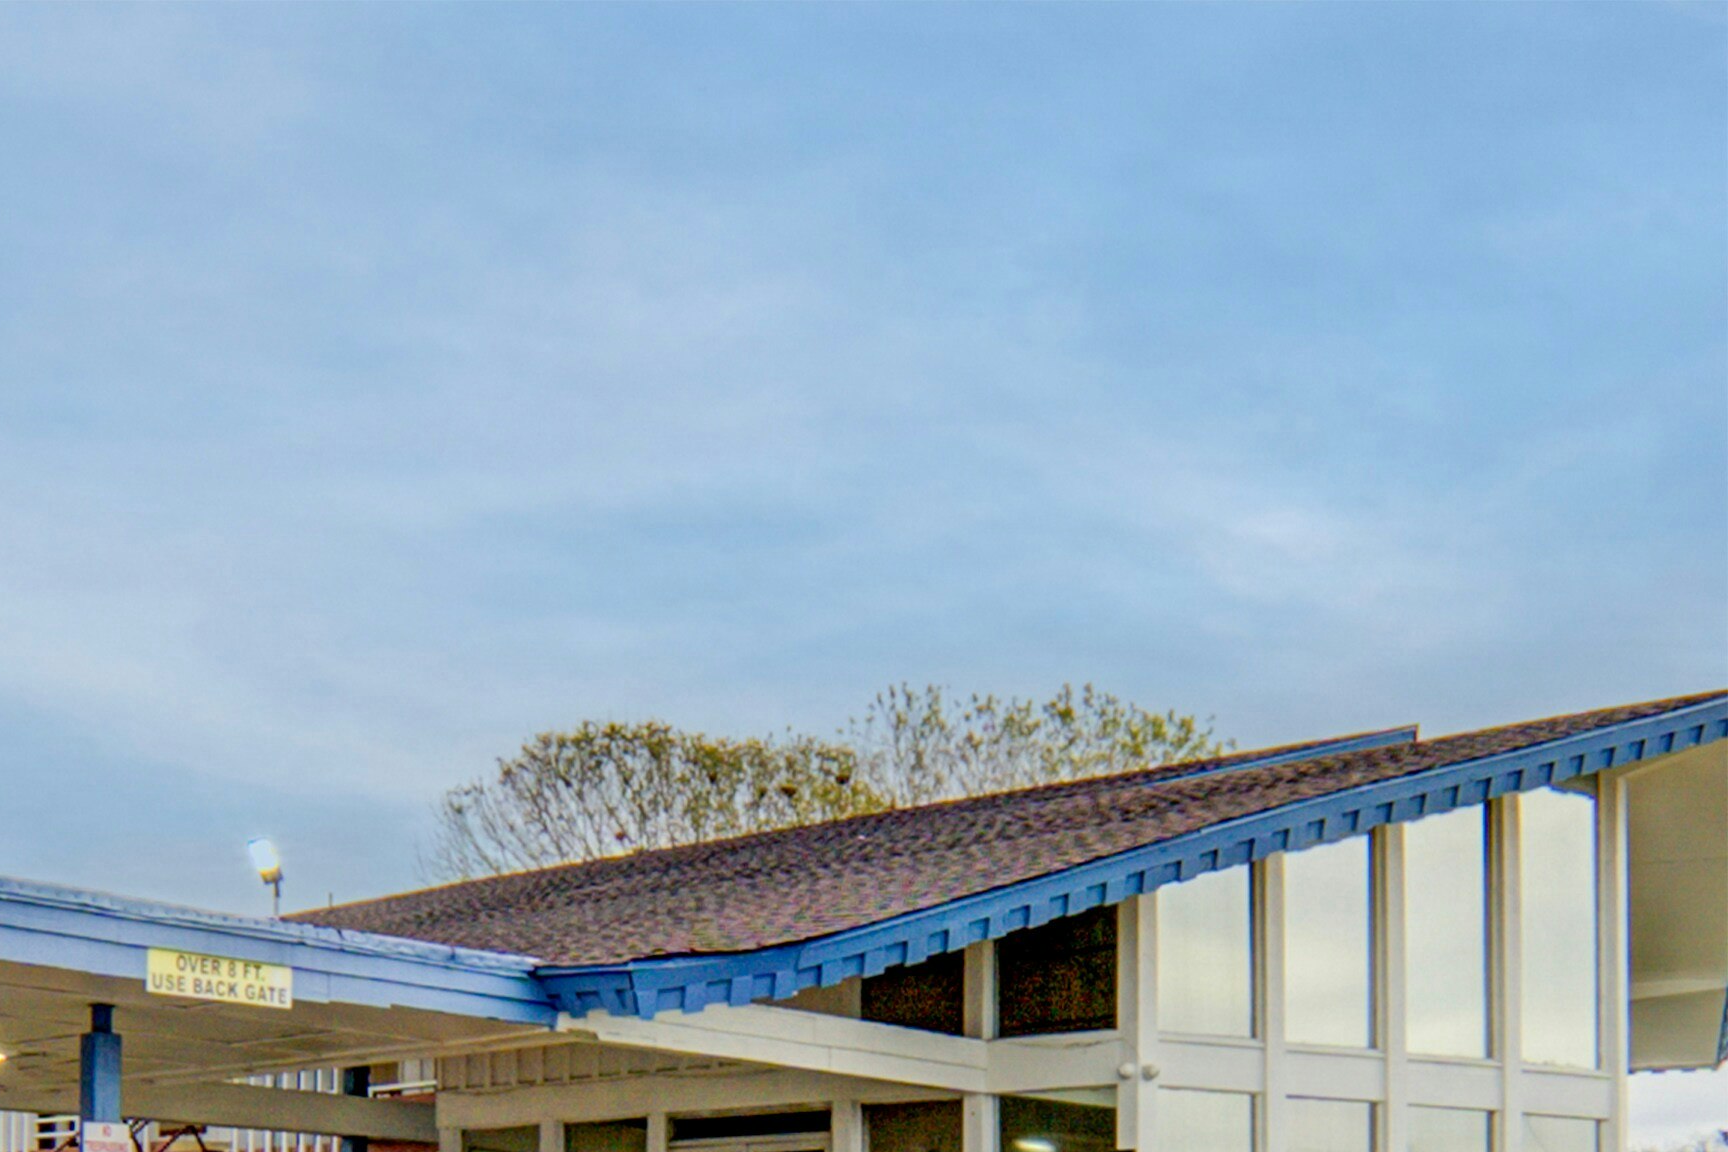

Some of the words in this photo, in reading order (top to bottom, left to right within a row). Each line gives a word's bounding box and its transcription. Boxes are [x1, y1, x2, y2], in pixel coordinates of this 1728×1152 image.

[176, 954, 221, 976] OVER
[227, 960, 237, 978] 8
[243, 962, 265, 981] FT.
[152, 973, 186, 993] USE
[193, 977, 238, 998] BACK
[244, 984, 288, 1005] GATE
